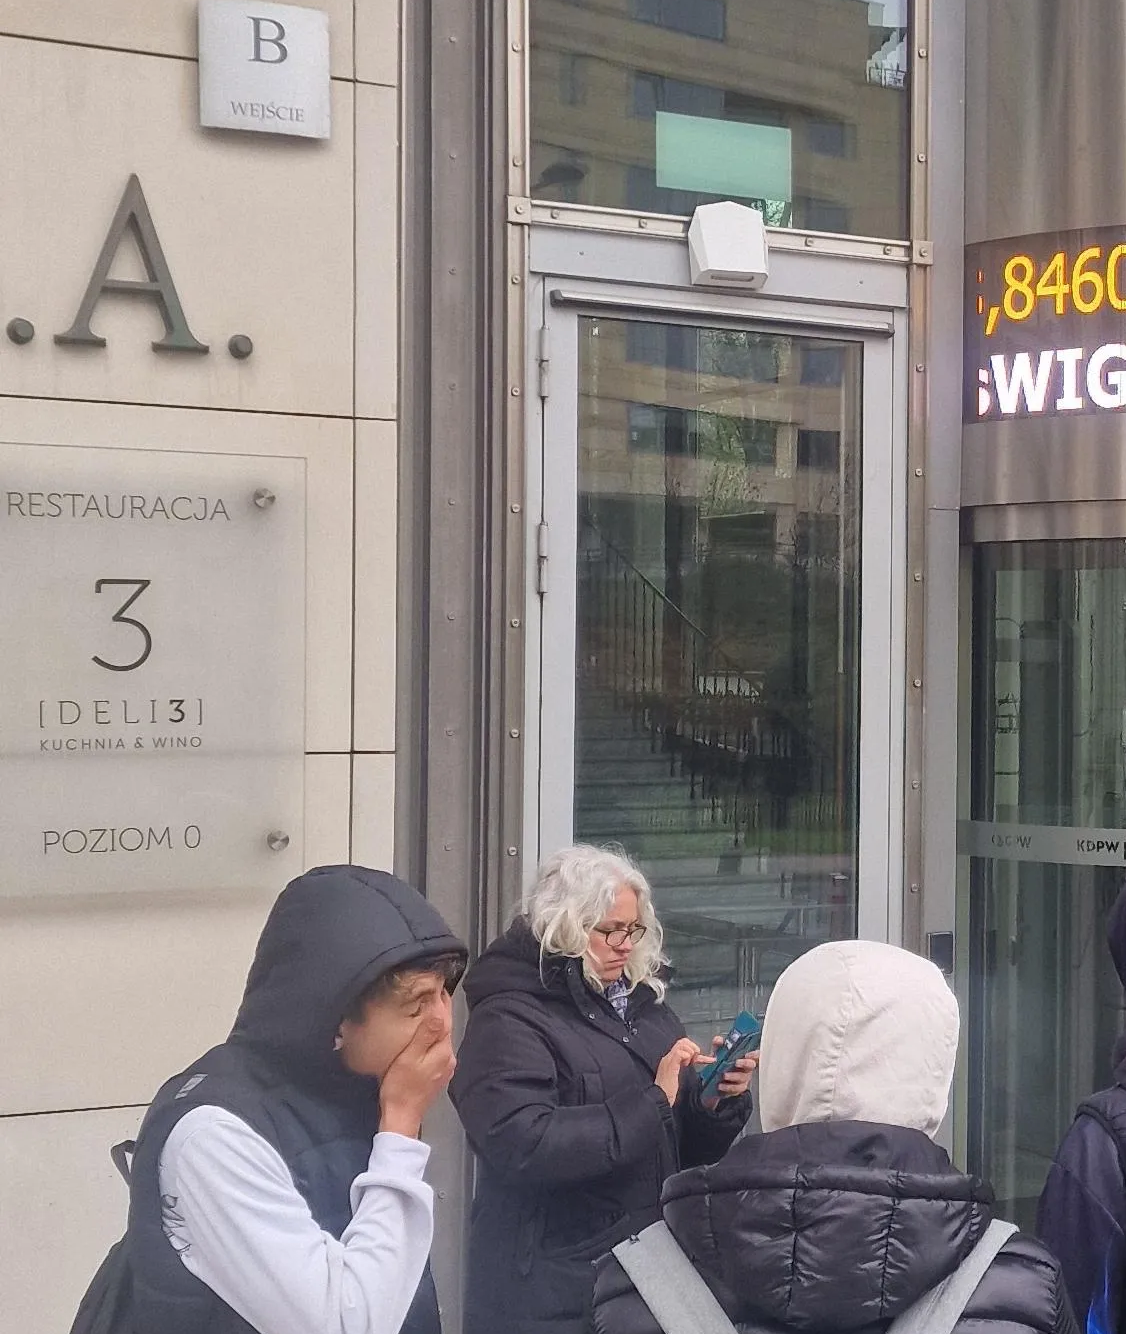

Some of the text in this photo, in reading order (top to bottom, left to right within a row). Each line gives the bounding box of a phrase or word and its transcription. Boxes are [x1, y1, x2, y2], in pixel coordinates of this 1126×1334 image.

[246, 16, 288, 65] B
[230, 98, 305, 124] WEJŚCIE
[7, 492, 231, 521] RESTAURACJA
[92, 579, 152, 671] 3
[40, 735, 202, 751] KUCHNIA & WINO
[43, 825, 172, 854] POZIOM
